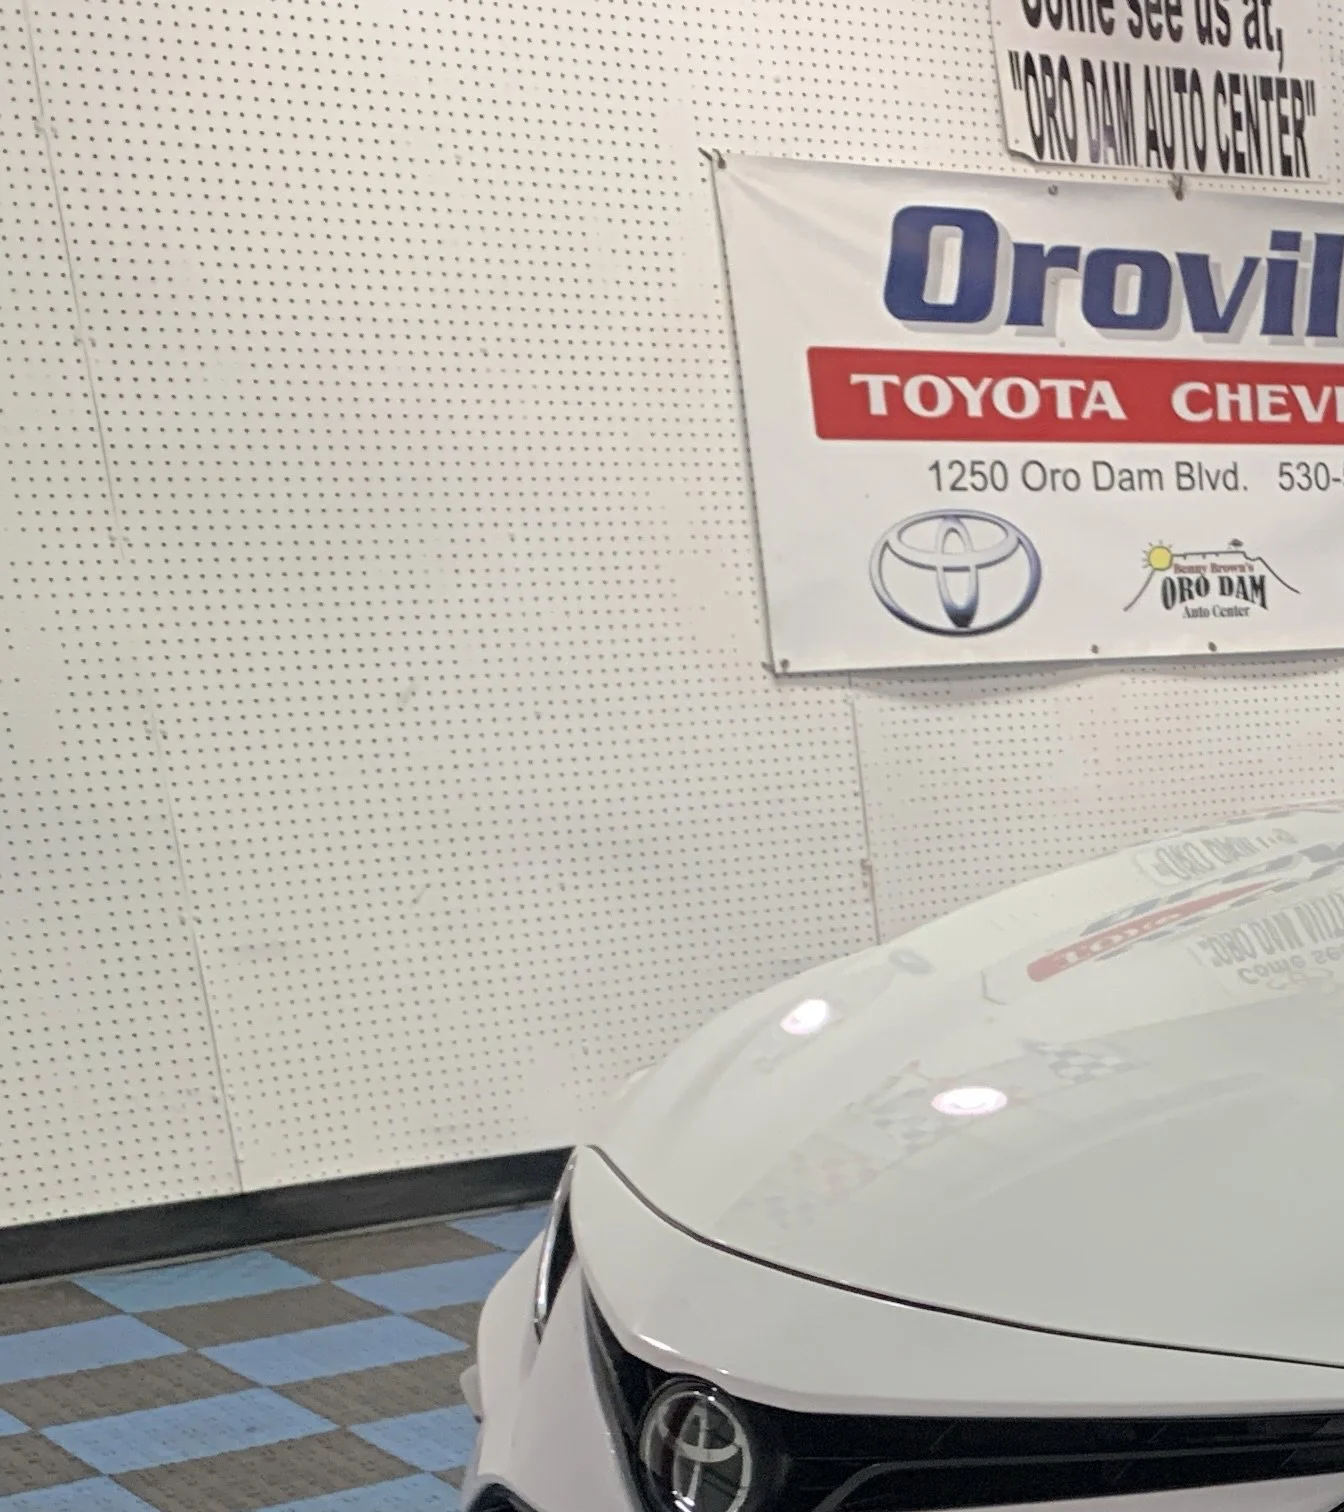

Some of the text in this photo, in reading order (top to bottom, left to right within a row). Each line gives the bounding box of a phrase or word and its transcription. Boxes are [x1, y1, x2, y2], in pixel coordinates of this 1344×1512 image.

[1007, 50, 1316, 179] "ORO DAM AUTO CENTER"
[849, 373, 1128, 421] TOYOTA
[928, 460, 1009, 493] 1250
[1021, 459, 1081, 492] Oro
[1092, 460, 1165, 492] Dam
[1175, 461, 1249, 492] Blvd.
[1160, 574, 1269, 611] ORO DAM
[1182, 604, 1251, 619] Auto Center
